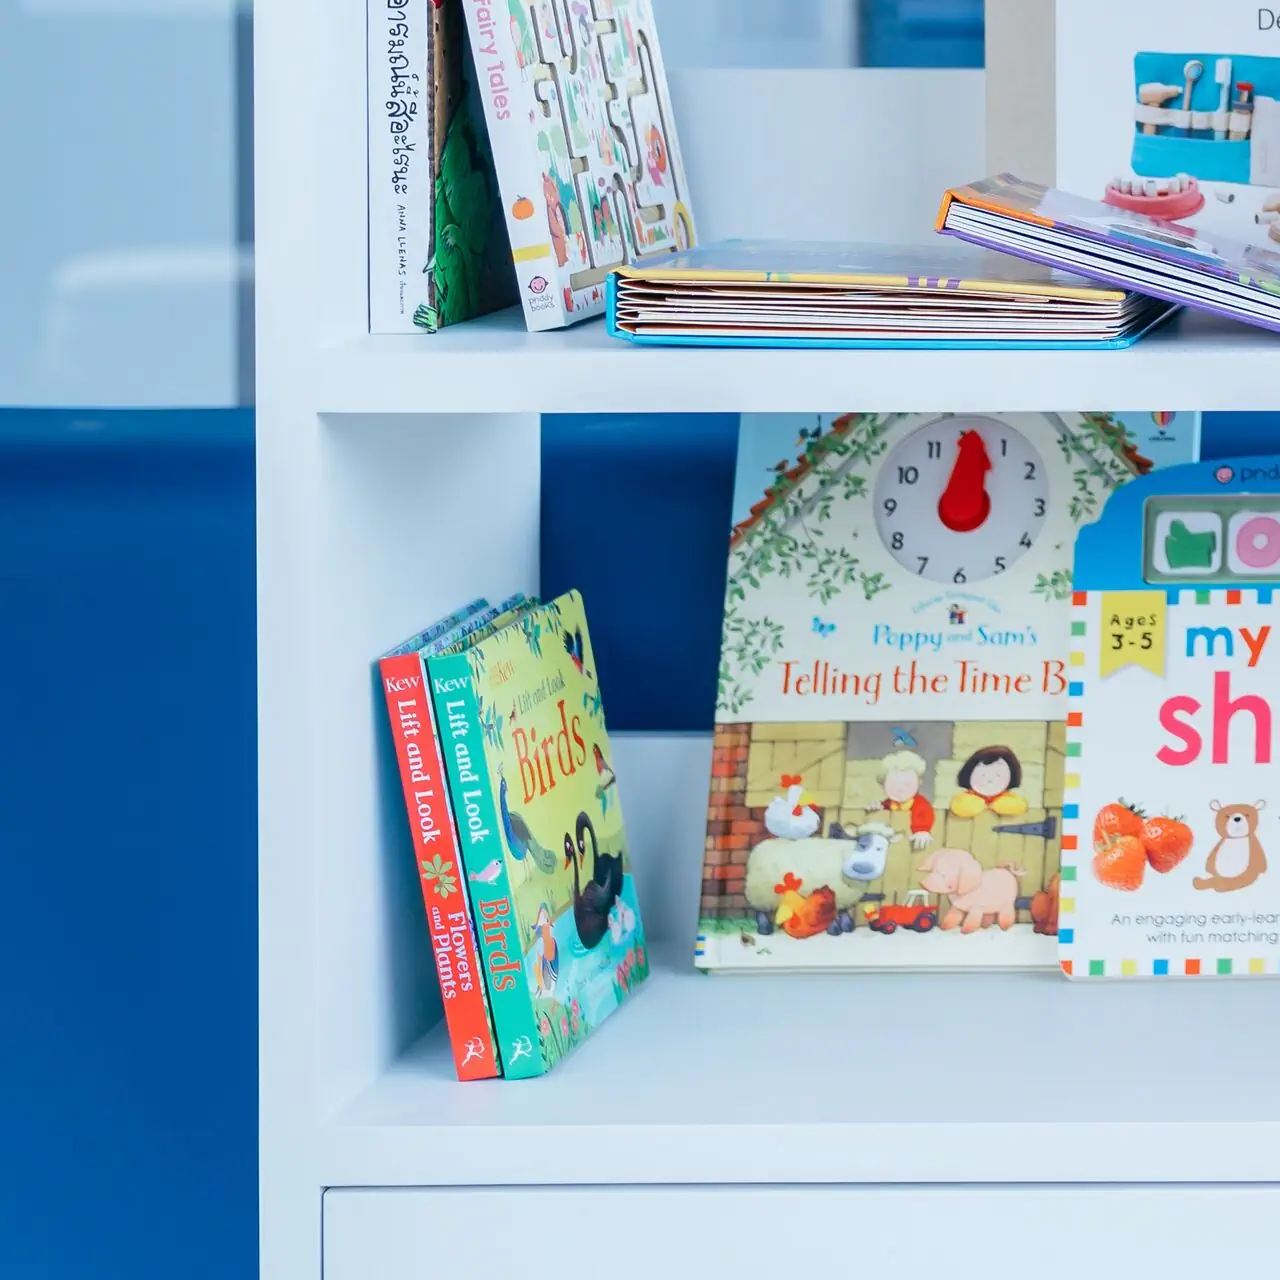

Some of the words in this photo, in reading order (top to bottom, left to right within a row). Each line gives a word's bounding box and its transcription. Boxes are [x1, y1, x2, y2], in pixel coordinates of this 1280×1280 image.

[485, 61, 512, 122] Tales
[396, 204, 407, 232] ANNA
[396, 236, 407, 276] LLENAS
[927, 440, 942, 460] 11
[1000, 438, 1008, 457] 1
[897, 466, 919, 485] 10
[1024, 461, 1037, 481] 2
[883, 498, 898, 517] 9
[1033, 497, 1047, 517] 3
[891, 531, 905, 551] 8
[1019, 531, 1033, 550] 4
[916, 556, 930, 576] 7
[953, 567, 968, 584] 6
[993, 556, 1007, 575] 5
[1110, 612, 1157, 630] Ages
[873, 623, 943, 652] Poppy
[976, 623, 1039, 646] Sam's
[1185, 624, 1272, 668] my
[386, 675, 420, 693] Kew
[434, 675, 468, 694] Kew
[777, 659, 883, 706] Telling
[893, 659, 949, 695] the
[953, 659, 1033, 695] Time
[398, 699, 421, 738] Lift
[446, 699, 470, 739] Lift
[406, 743, 431, 783] and
[454, 743, 480, 784] and
[511, 699, 587, 805] Birds
[414, 789, 441, 845] Look
[462, 789, 490, 845] Look
[431, 906, 446, 931] and
[1111, 912, 1132, 926] An
[1135, 912, 1208, 930] engaging
[479, 896, 522, 993] Birds
[1146, 930, 1177, 945] with
[1180, 929, 1204, 944] fun
[1207, 928, 1279, 947] matching
[447, 911, 474, 993] Flowers
[434, 933, 457, 999] Plants
